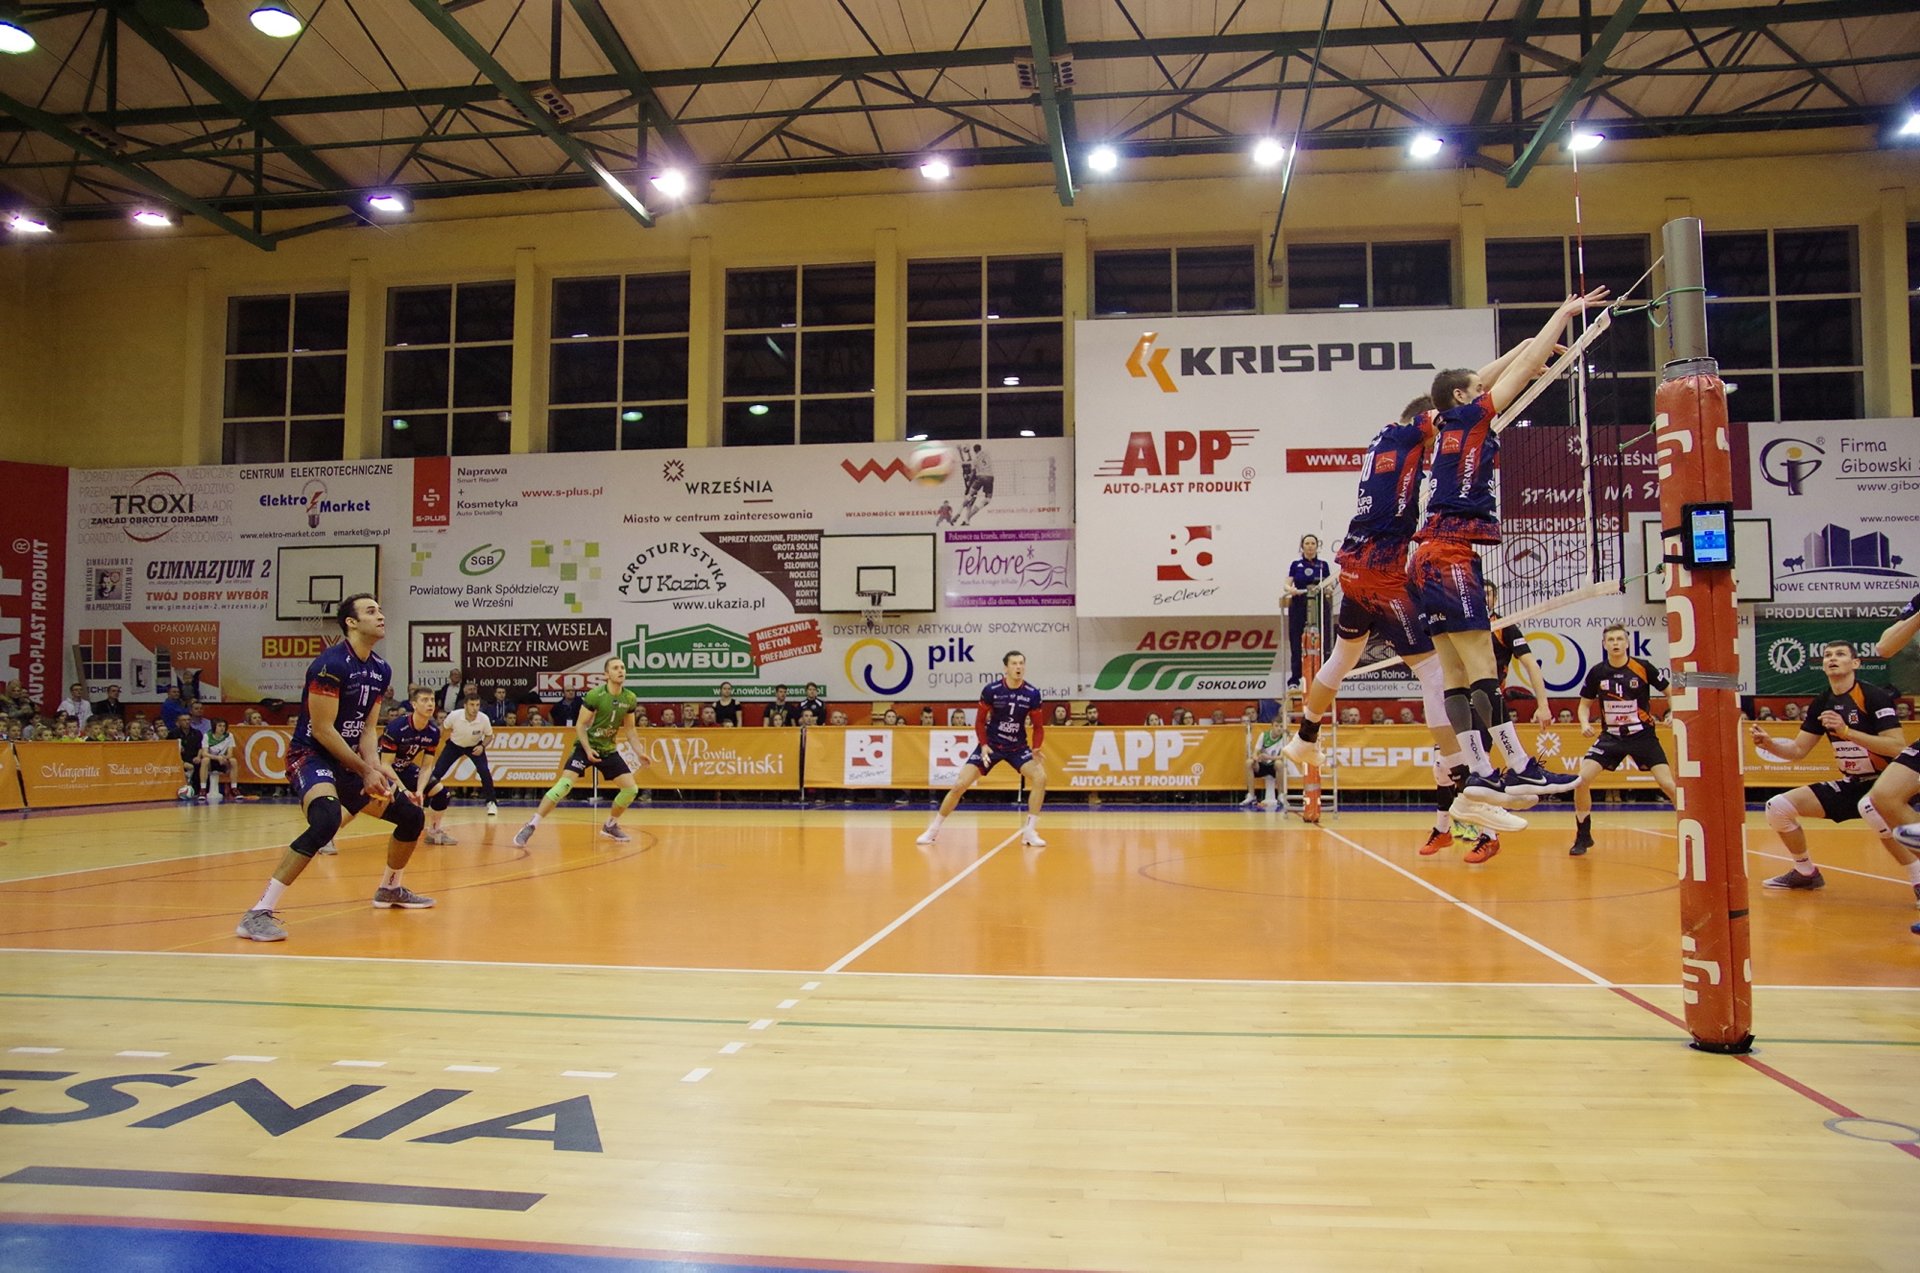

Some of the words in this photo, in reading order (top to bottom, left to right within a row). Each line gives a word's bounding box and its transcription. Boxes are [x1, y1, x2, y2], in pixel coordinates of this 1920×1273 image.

[1181, 342, 1435, 376] KRISPOL
[1841, 438, 1887, 452] Firma
[1121, 431, 1231, 476] APP
[1841, 457, 1912, 473] Gibowski
[239, 468, 285, 480] CENTRUM
[290, 464, 393, 478] ELEKTROTECHNICZNE
[457, 468, 508, 477] Naprawa
[685, 477, 773, 494] WRZEŚNIA
[1103, 482, 1184, 495] AUTO-PLAST
[1188, 481, 1251, 493] PRODUKT
[521, 487, 604, 498] www.s-plus.pl
[110, 494, 194, 515] TROXI
[259, 495, 307, 506] Elektro
[320, 500, 371, 513] Market
[456, 500, 518, 510] Kosmetyka
[91, 517, 127, 525] ZAKŁAD
[129, 516, 168, 524] OBROTU
[171, 515, 219, 523] ODPADAMI
[623, 513, 660, 524] Miasto
[675, 513, 720, 522] centrum
[723, 509, 813, 521] zainteresowania
[845, 510, 896, 518] WIADOMOŚCI
[1860, 515, 1920, 523] www.nowece
[240, 530, 326, 539] www.elektro-market.com
[333, 528, 391, 537] emarket@wp.pl
[719, 535, 749, 543] IMPREZY
[787, 533, 819, 541] FIRMOWE
[796, 543, 818, 551] SOLNA
[471, 556, 494, 566] SGB
[795, 552, 819, 560] ZABAW
[31, 539, 48, 610] PRODUKT
[146, 560, 255, 584] GIMNAZJUM
[261, 559, 272, 578] 2
[618, 542, 727, 595] AGROTURYSTYKA
[789, 571, 818, 579] NOCLEGI
[409, 585, 463, 596] Powiatowy
[466, 585, 492, 595] Bank
[495, 583, 560, 595] Spółdzielczy
[637, 576, 651, 593] U
[657, 573, 710, 592] Kazia
[794, 580, 818, 588] KAJAKI
[1807, 581, 1861, 591] CENTRUM
[1863, 578, 1920, 590] WRZEŚNIA
[146, 590, 179, 601] TWÓJ
[183, 590, 223, 601] DOBRY
[226, 589, 269, 600] WYBÓR
[1153, 587, 1220, 606] BeClever
[472, 597, 514, 608] Wrześni
[672, 598, 765, 611] www.ukazia.pl
[1765, 606, 1853, 619] PRODUCENT
[153, 624, 217, 634] OPAKOWANIA
[833, 624, 910, 636] DYSTRYBUTOR
[917, 622, 983, 634] ARTYKUŁÓW
[988, 621, 1070, 634] SPOŻYWCZYCH
[1516, 617, 1581, 629] STRYBUTOR
[467, 624, 542, 637] BANKIETY,
[547, 623, 608, 637] WESELA,
[756, 621, 812, 641] MIESZKANIA
[170, 637, 217, 646] DISPLAY'E
[467, 641, 521, 652] IMPREZY
[526, 640, 589, 651] FIRMOWE
[758, 637, 791, 651] BETON
[1136, 630, 1278, 651] AGROPOL
[176, 651, 216, 661] STANDY
[426, 646, 448, 658] HK
[760, 643, 817, 663] PREFABRYKATY
[928, 637, 975, 670] pik
[29, 613, 46, 705] AUTO-PLAST
[466, 656, 471, 668] I
[476, 656, 549, 668] RODZINNE
[628, 651, 751, 669] NOWBUD
[418, 677, 449, 686] HOTE
[480, 679, 494, 687] 600
[496, 679, 511, 687] 900
[513, 678, 528, 687] 380
[928, 671, 974, 688] grupa
[1197, 680, 1266, 690] SOKOŁOWO
[1357, 682, 1398, 694] Gąsiorek
[1615, 683, 1623, 697] 4
[1008, 702, 1016, 715] 7
[487, 732, 566, 750] GROPOL
[1087, 731, 1185, 773] APP
[1326, 746, 1436, 768] RISPO
[1070, 776, 1142, 788] AUTO-PLAST
[1145, 775, 1201, 787] PRODUKT
